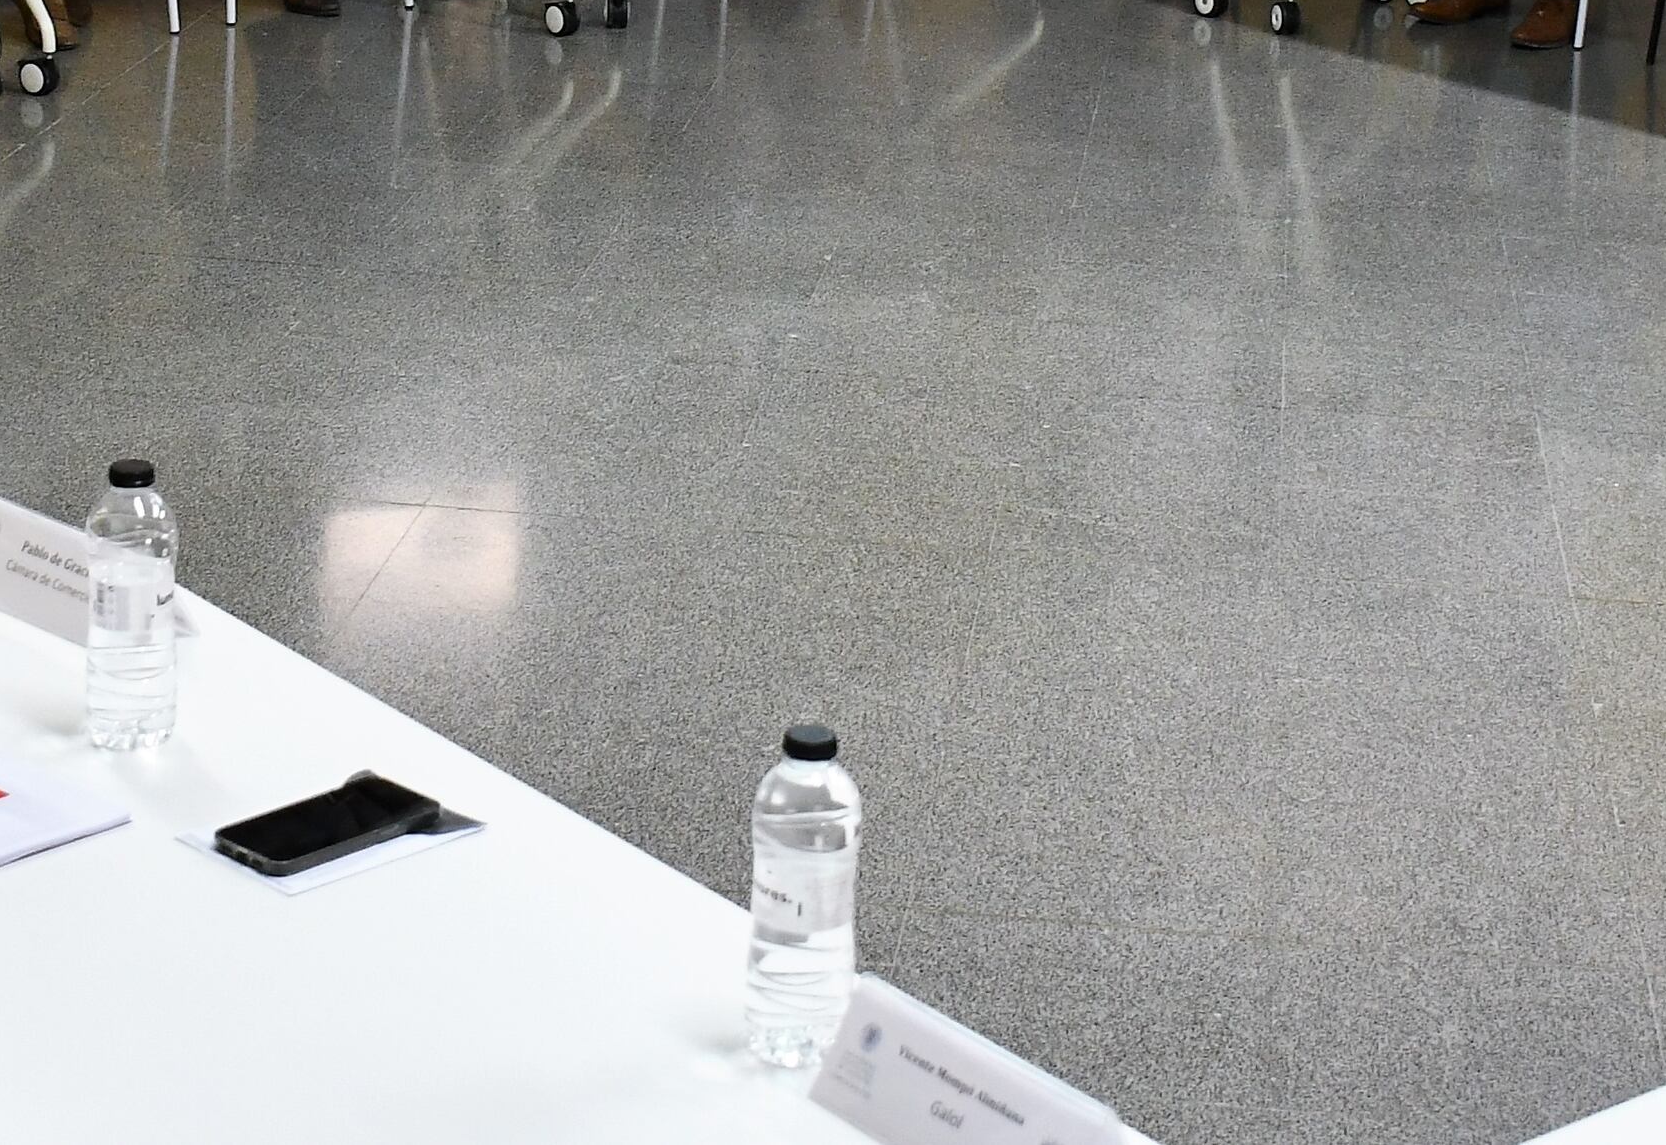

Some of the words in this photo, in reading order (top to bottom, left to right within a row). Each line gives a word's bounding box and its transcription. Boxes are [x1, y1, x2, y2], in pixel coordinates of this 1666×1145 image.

[20, 539, 50, 560] Pablo
[49, 552, 63, 566] de
[5, 558, 38, 582] Cámara
[38, 573, 52, 587] de
[898, 1043, 936, 1075] Vicente
